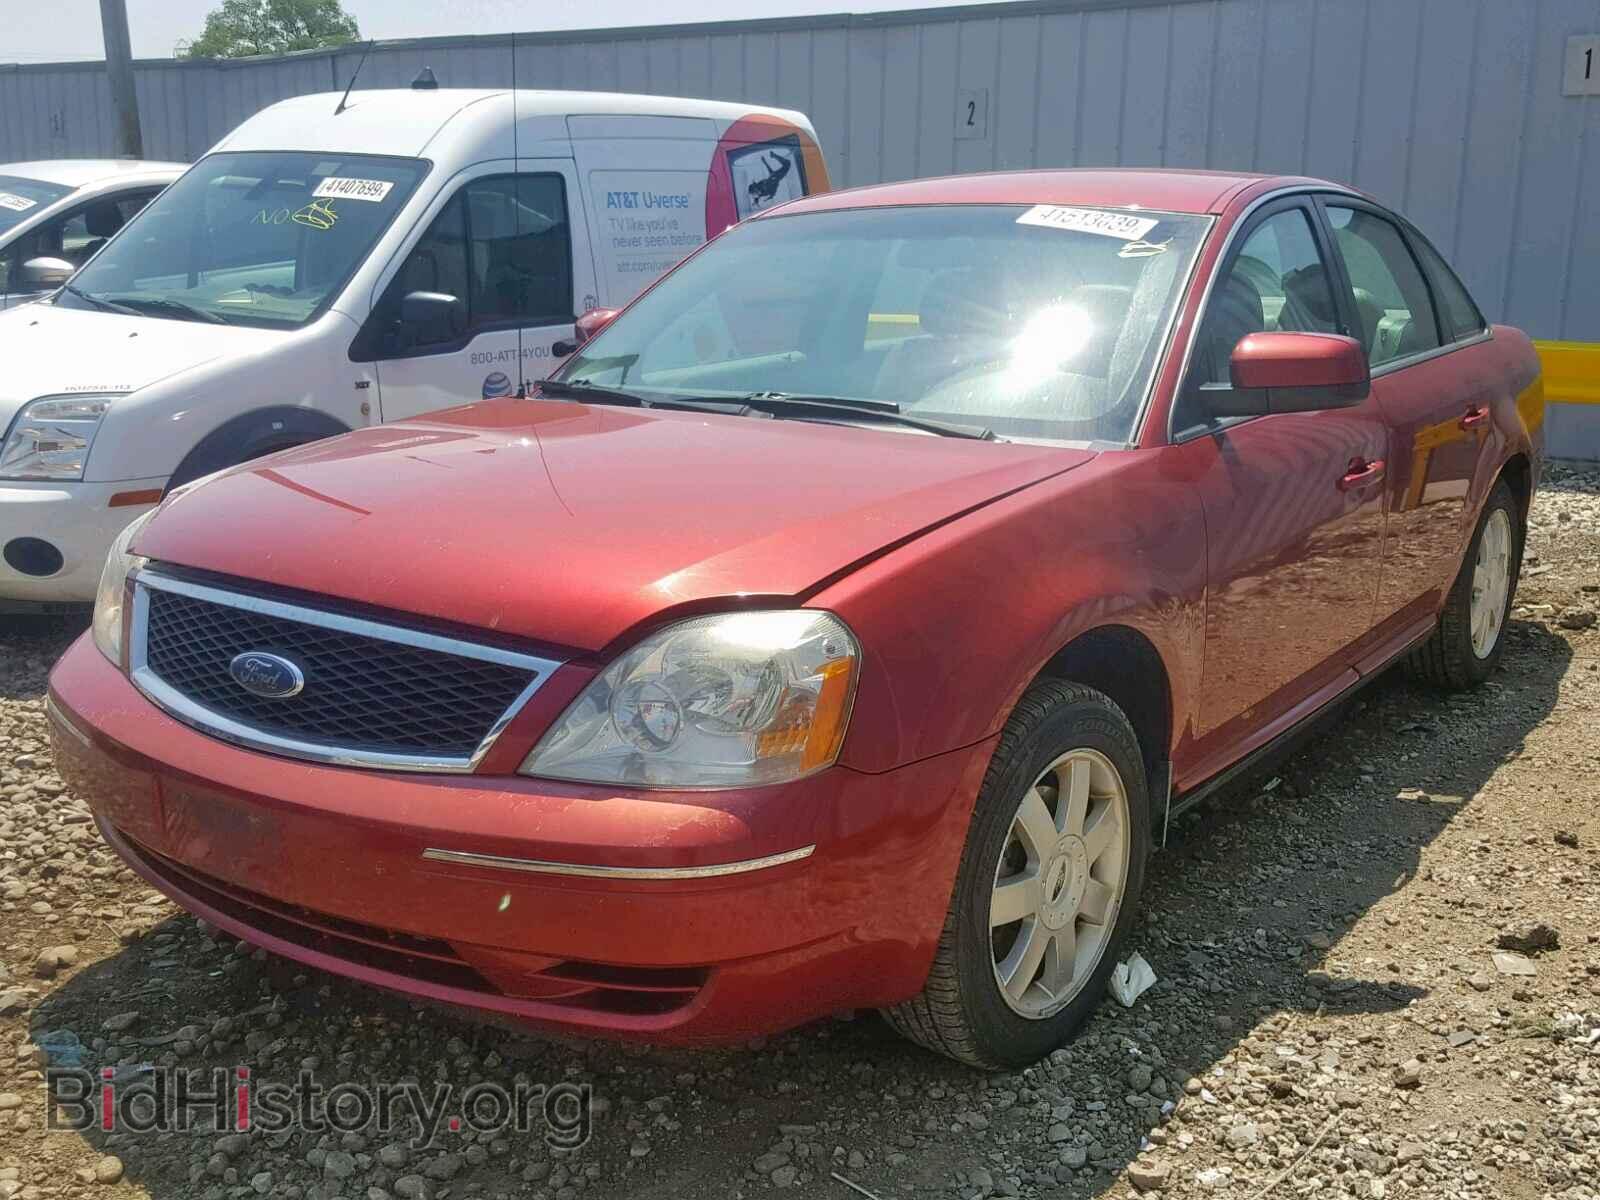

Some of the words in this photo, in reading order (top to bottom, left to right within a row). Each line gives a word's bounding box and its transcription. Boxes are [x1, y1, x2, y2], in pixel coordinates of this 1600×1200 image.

[1584, 47, 1593, 80] 1
[966, 100, 976, 126] 2
[606, 191, 639, 209] AT&T
[608, 217, 625, 231] TV
[627, 216, 645, 231] like
[645, 217, 679, 233] you've
[612, 234, 642, 248] never
[643, 235, 668, 247] seen
[241, 658, 281, 689] Ford
